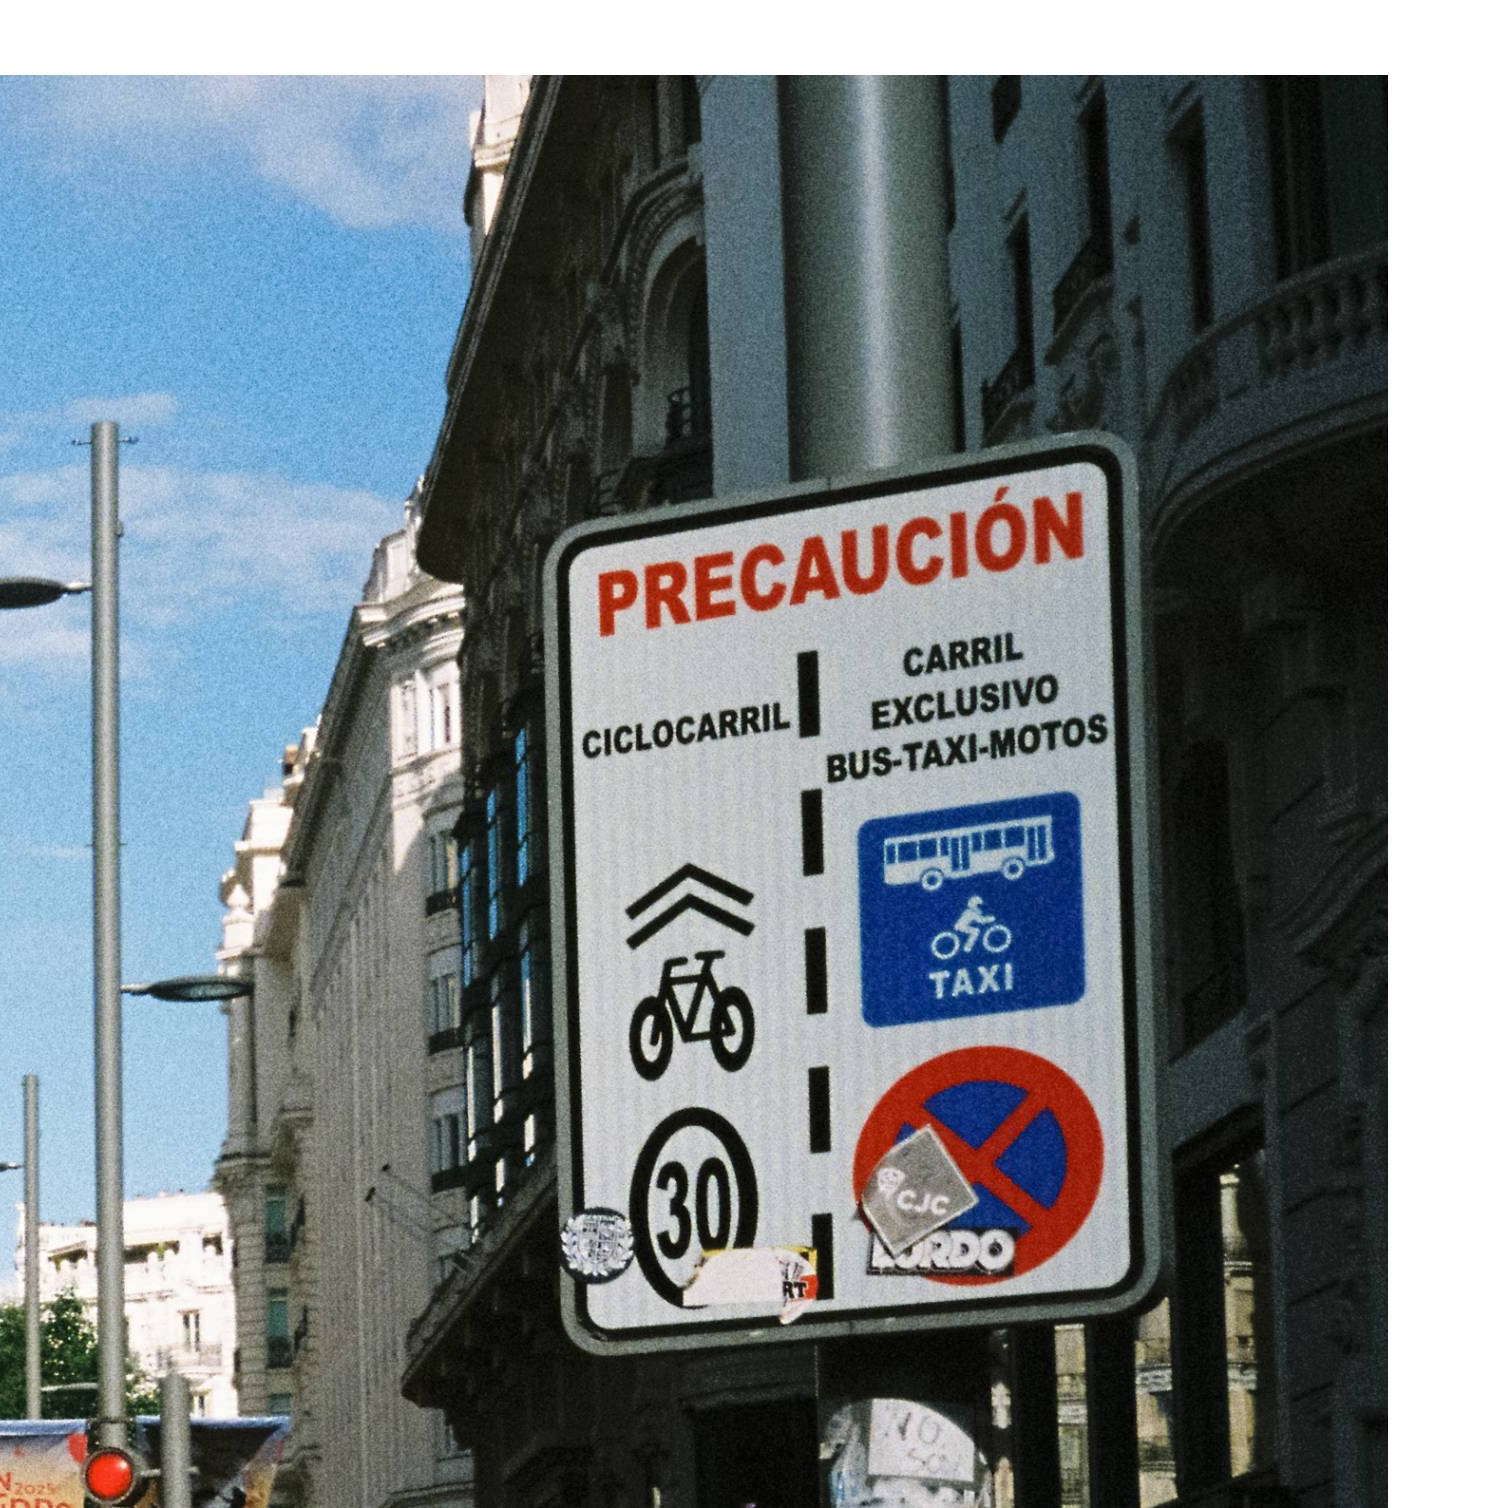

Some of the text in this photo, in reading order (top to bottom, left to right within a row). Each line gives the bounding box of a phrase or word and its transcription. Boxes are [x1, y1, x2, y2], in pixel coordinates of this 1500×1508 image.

[598, 486, 1086, 637] PRECAUCIÓN
[903, 632, 1024, 677] CARRIL
[871, 673, 1059, 730] EXCLUSIVO
[581, 702, 791, 759] CICLOCARRIL
[826, 713, 1108, 783] BUS-TAXI-MOTOS
[929, 963, 1013, 999] TAXI
[656, 1157, 732, 1260] 30
[896, 1189, 950, 1215] CJC
